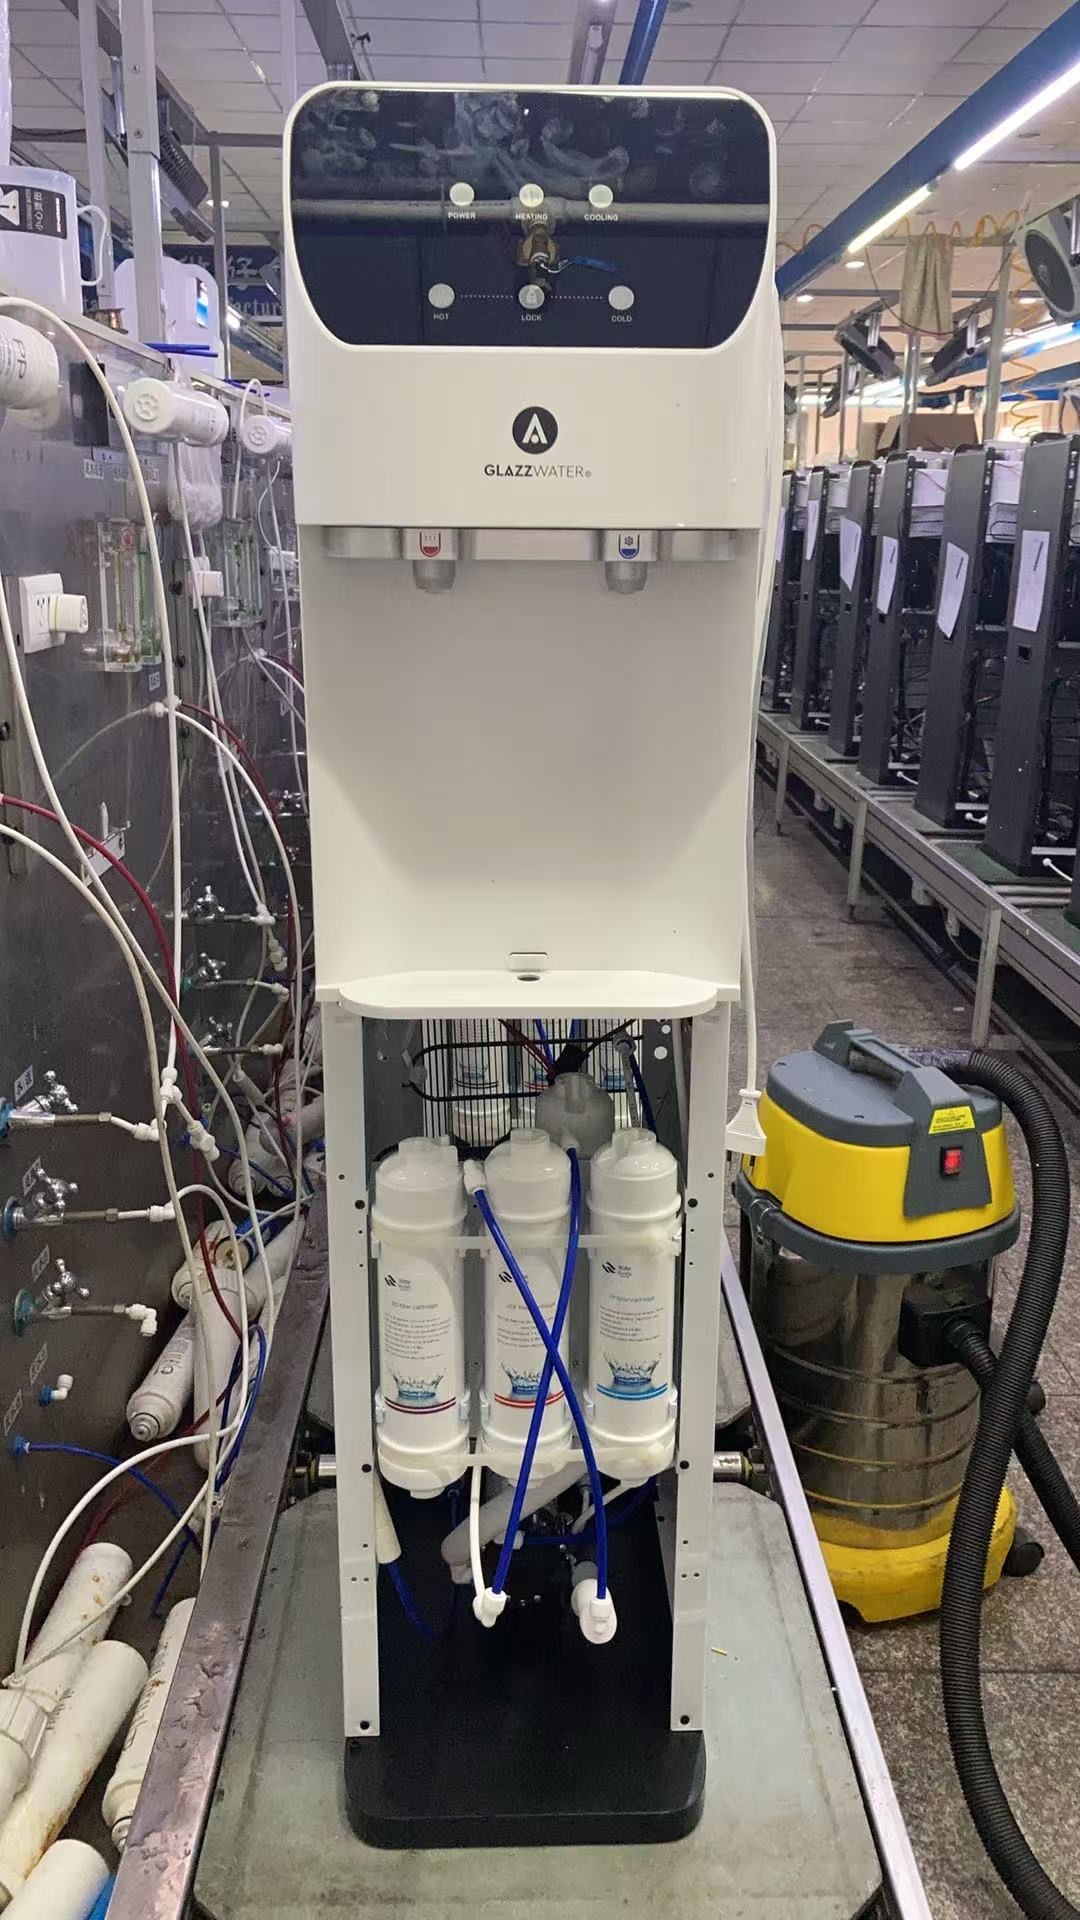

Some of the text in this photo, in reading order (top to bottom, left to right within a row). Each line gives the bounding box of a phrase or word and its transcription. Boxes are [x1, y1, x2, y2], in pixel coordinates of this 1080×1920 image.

[447, 211, 476, 220] POWER
[515, 212, 549, 221] HEATING
[584, 213, 619, 222] COOLING
[433, 313, 449, 321] HOT
[521, 314, 542, 322] LOCK
[611, 315, 633, 323] COLD
